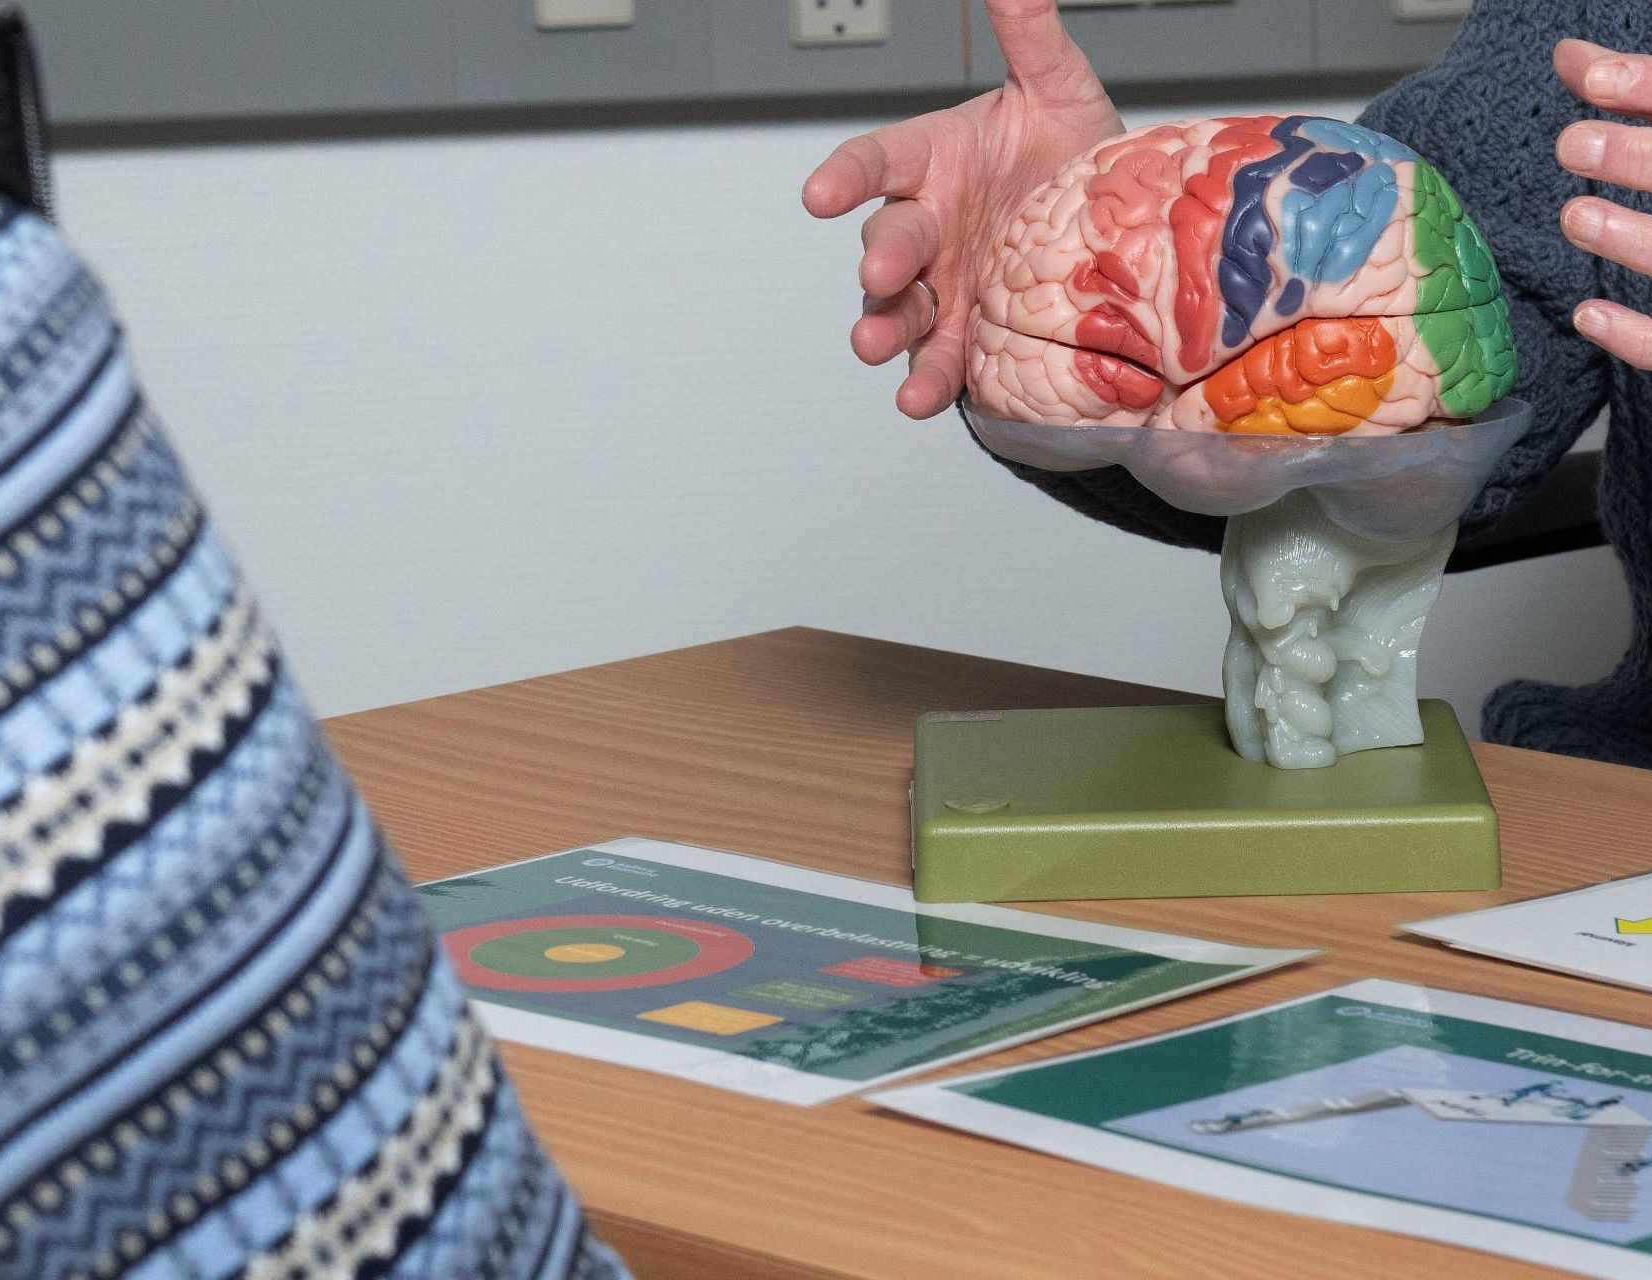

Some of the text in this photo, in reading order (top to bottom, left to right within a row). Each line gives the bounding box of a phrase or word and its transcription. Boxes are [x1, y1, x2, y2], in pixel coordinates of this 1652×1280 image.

[554, 875, 692, 909] Udfordring
[691, 903, 761, 922] uden
[760, 917, 959, 960] overbelastning
[982, 955, 1117, 992] udvikling
[1575, 931, 1637, 948] Maximal
